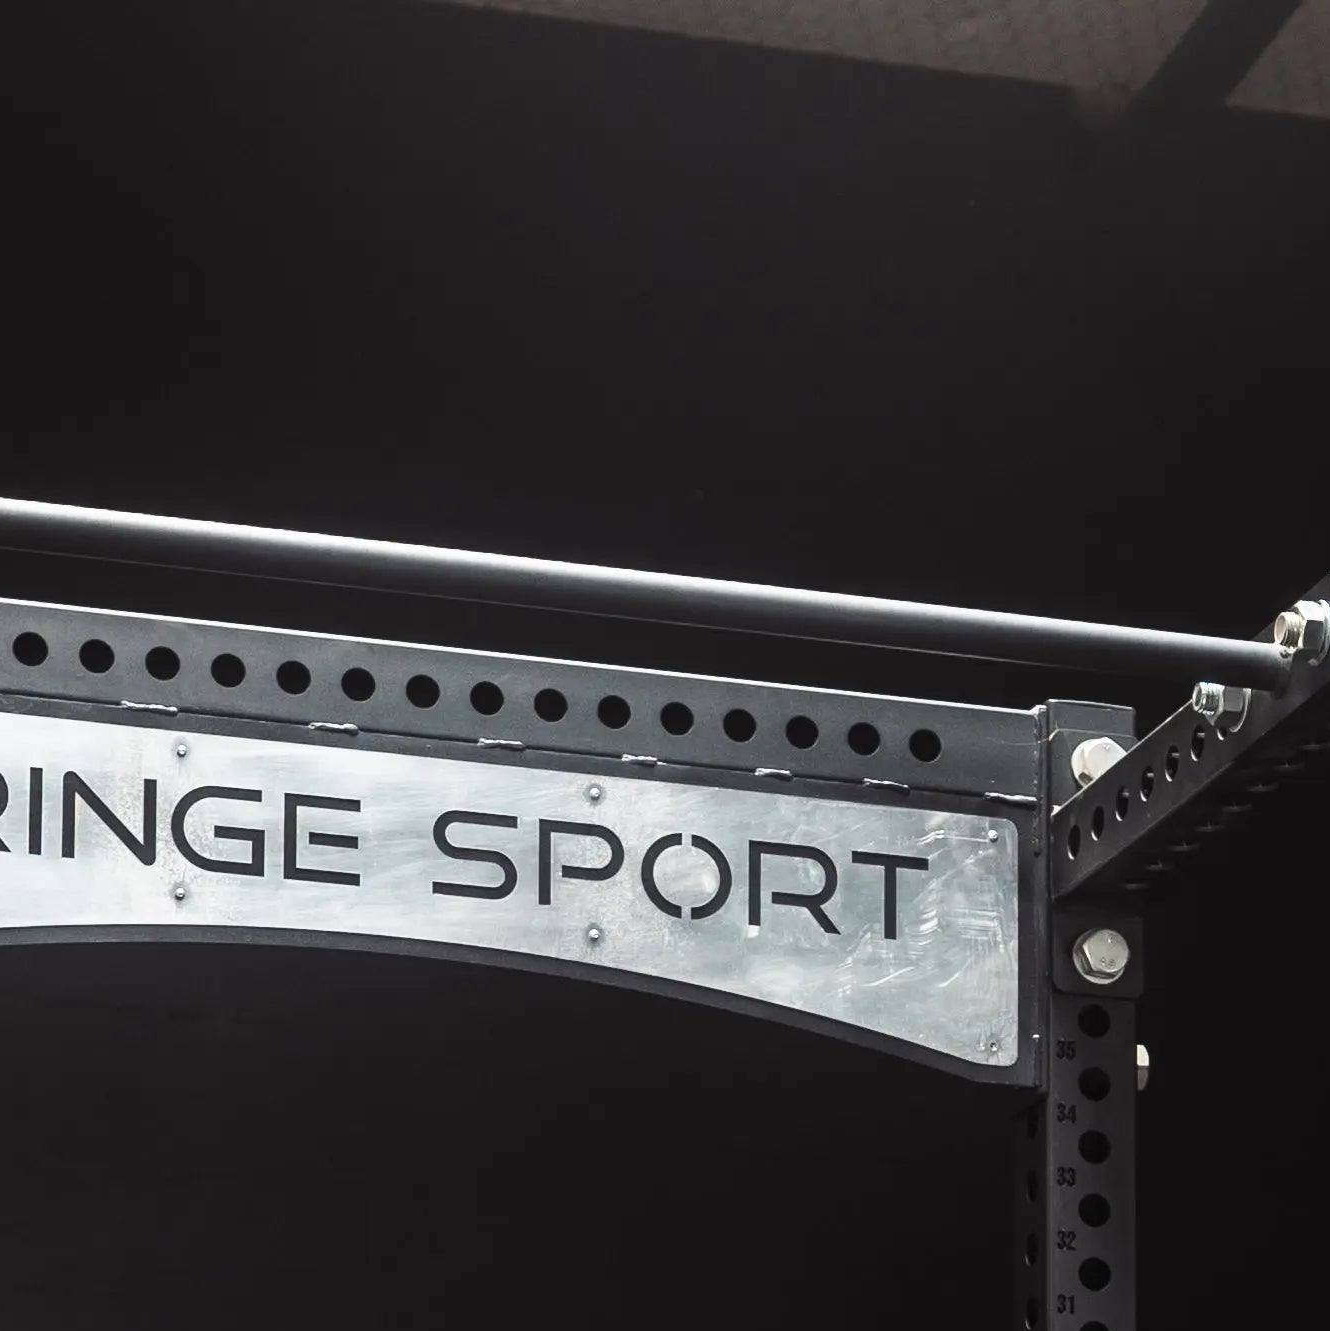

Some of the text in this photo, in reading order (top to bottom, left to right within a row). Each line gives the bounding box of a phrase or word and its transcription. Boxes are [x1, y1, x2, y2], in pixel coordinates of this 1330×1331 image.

[432, 809, 930, 940] SPORT
[1057, 1040, 1075, 1059] 35
[1057, 1103, 1076, 1123] 34
[1057, 1167, 1076, 1186] 33
[1057, 1230, 1076, 1250] 32
[1057, 1295, 1075, 1314] 31
